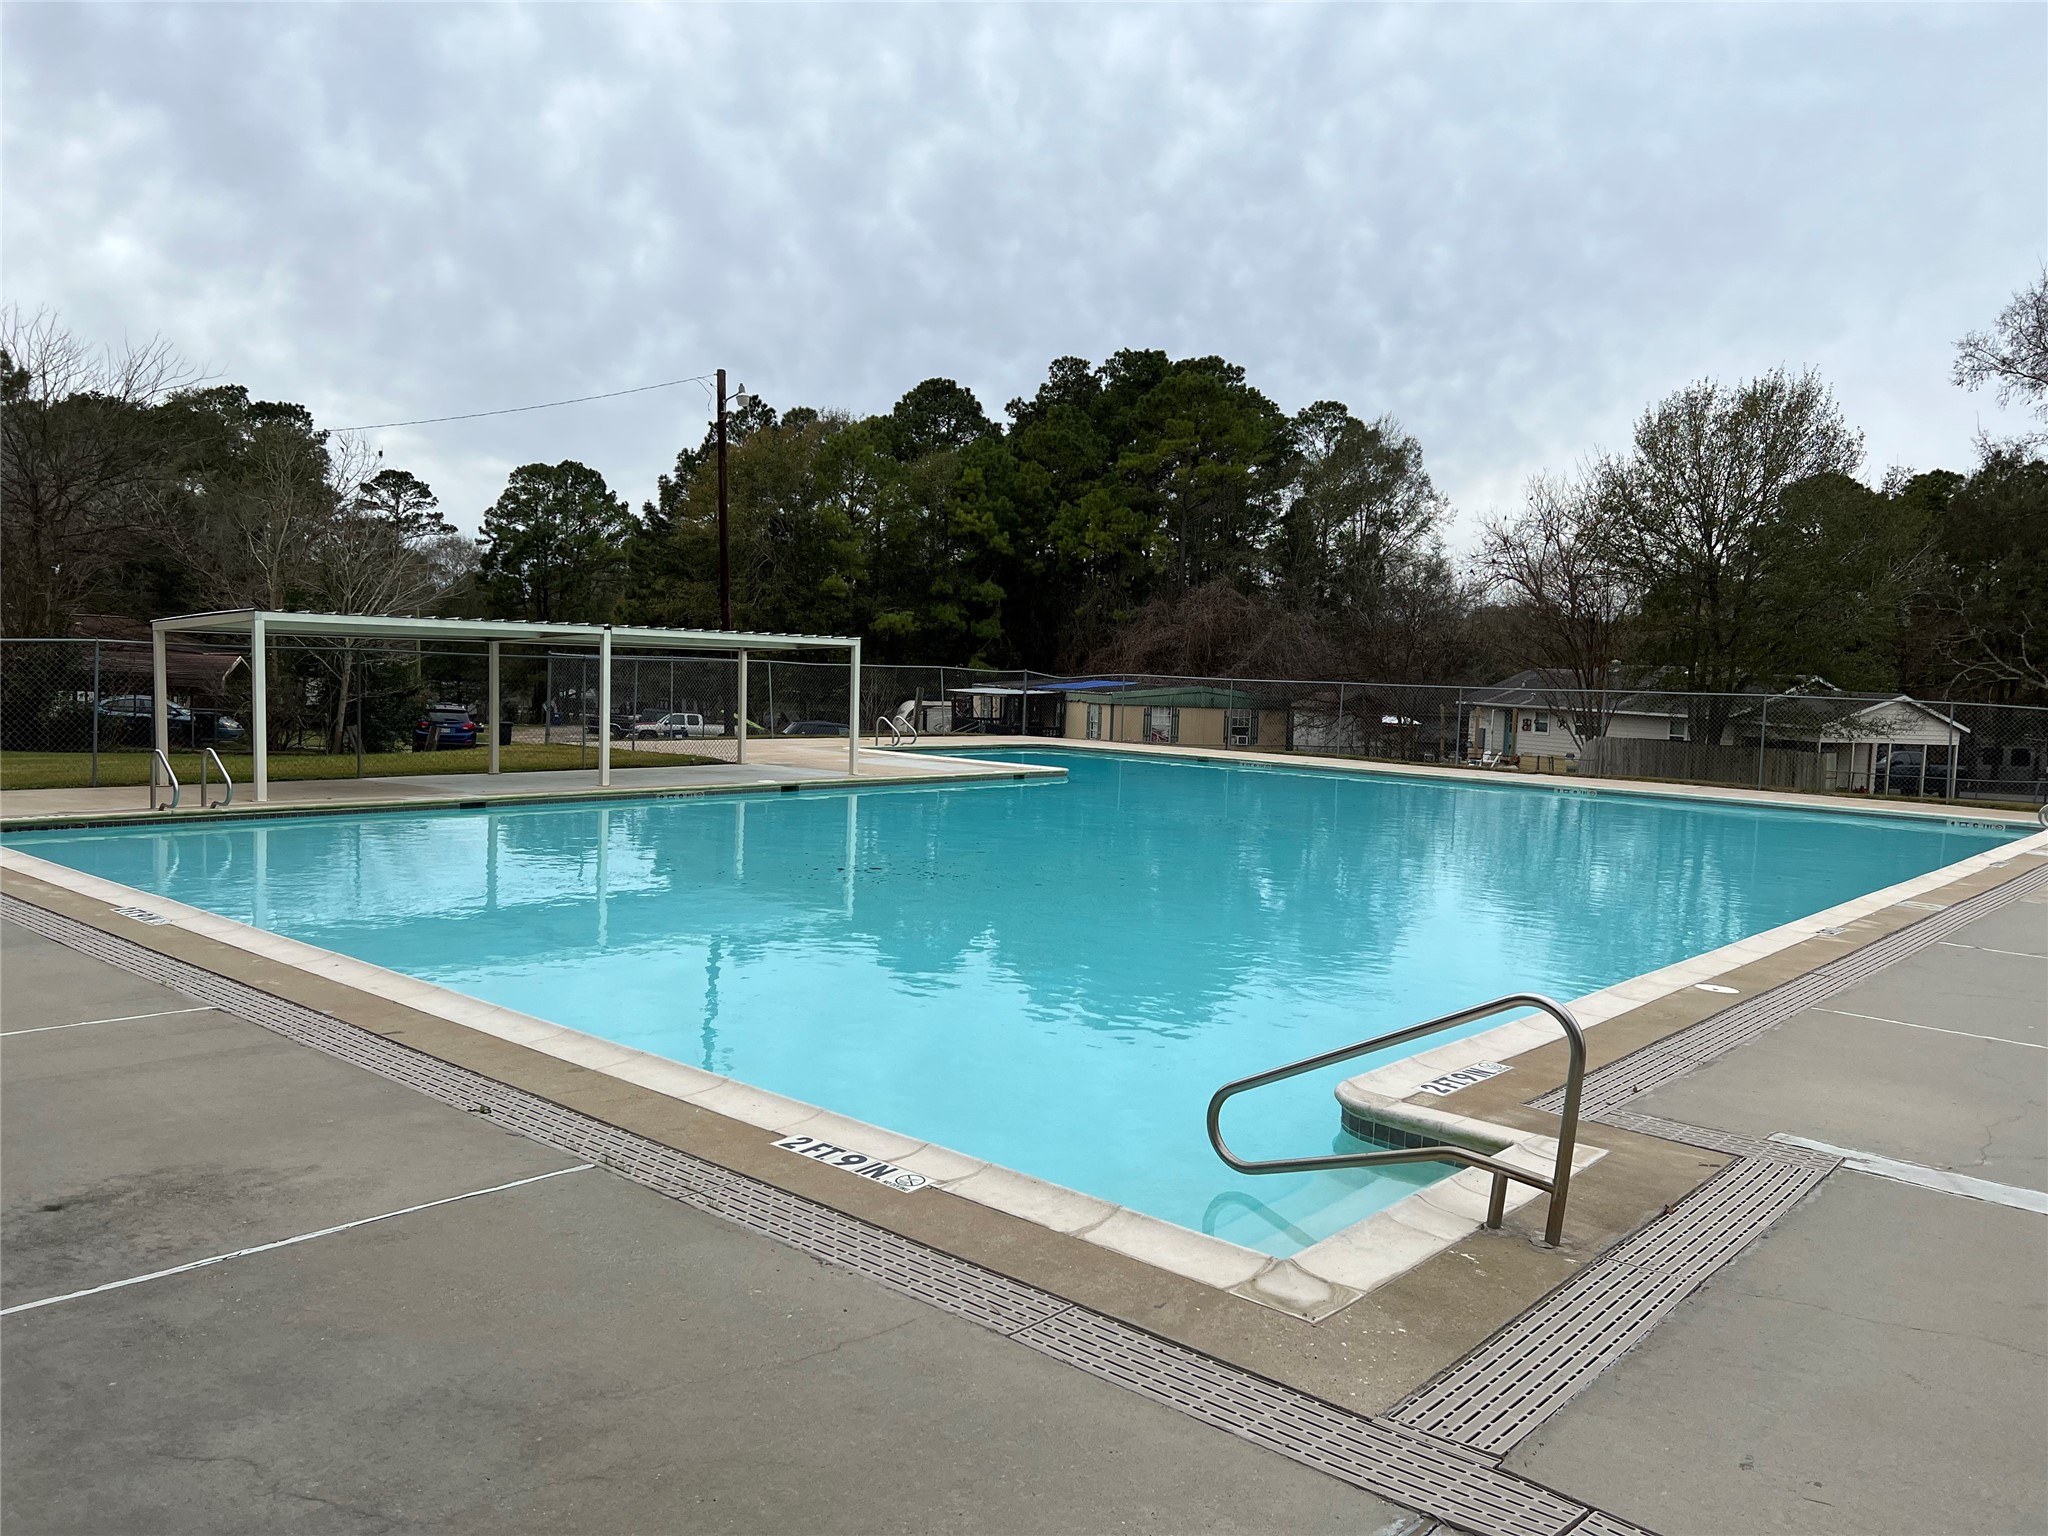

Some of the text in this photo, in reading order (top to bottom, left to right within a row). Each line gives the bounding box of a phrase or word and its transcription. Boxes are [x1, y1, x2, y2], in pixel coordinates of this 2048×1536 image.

[1420, 1084, 1452, 1094] 2
[1451, 1073, 1478, 1082] 9
[779, 1137, 813, 1149] 2
[799, 1143, 847, 1160] FT.
[832, 1154, 868, 1166] 9
